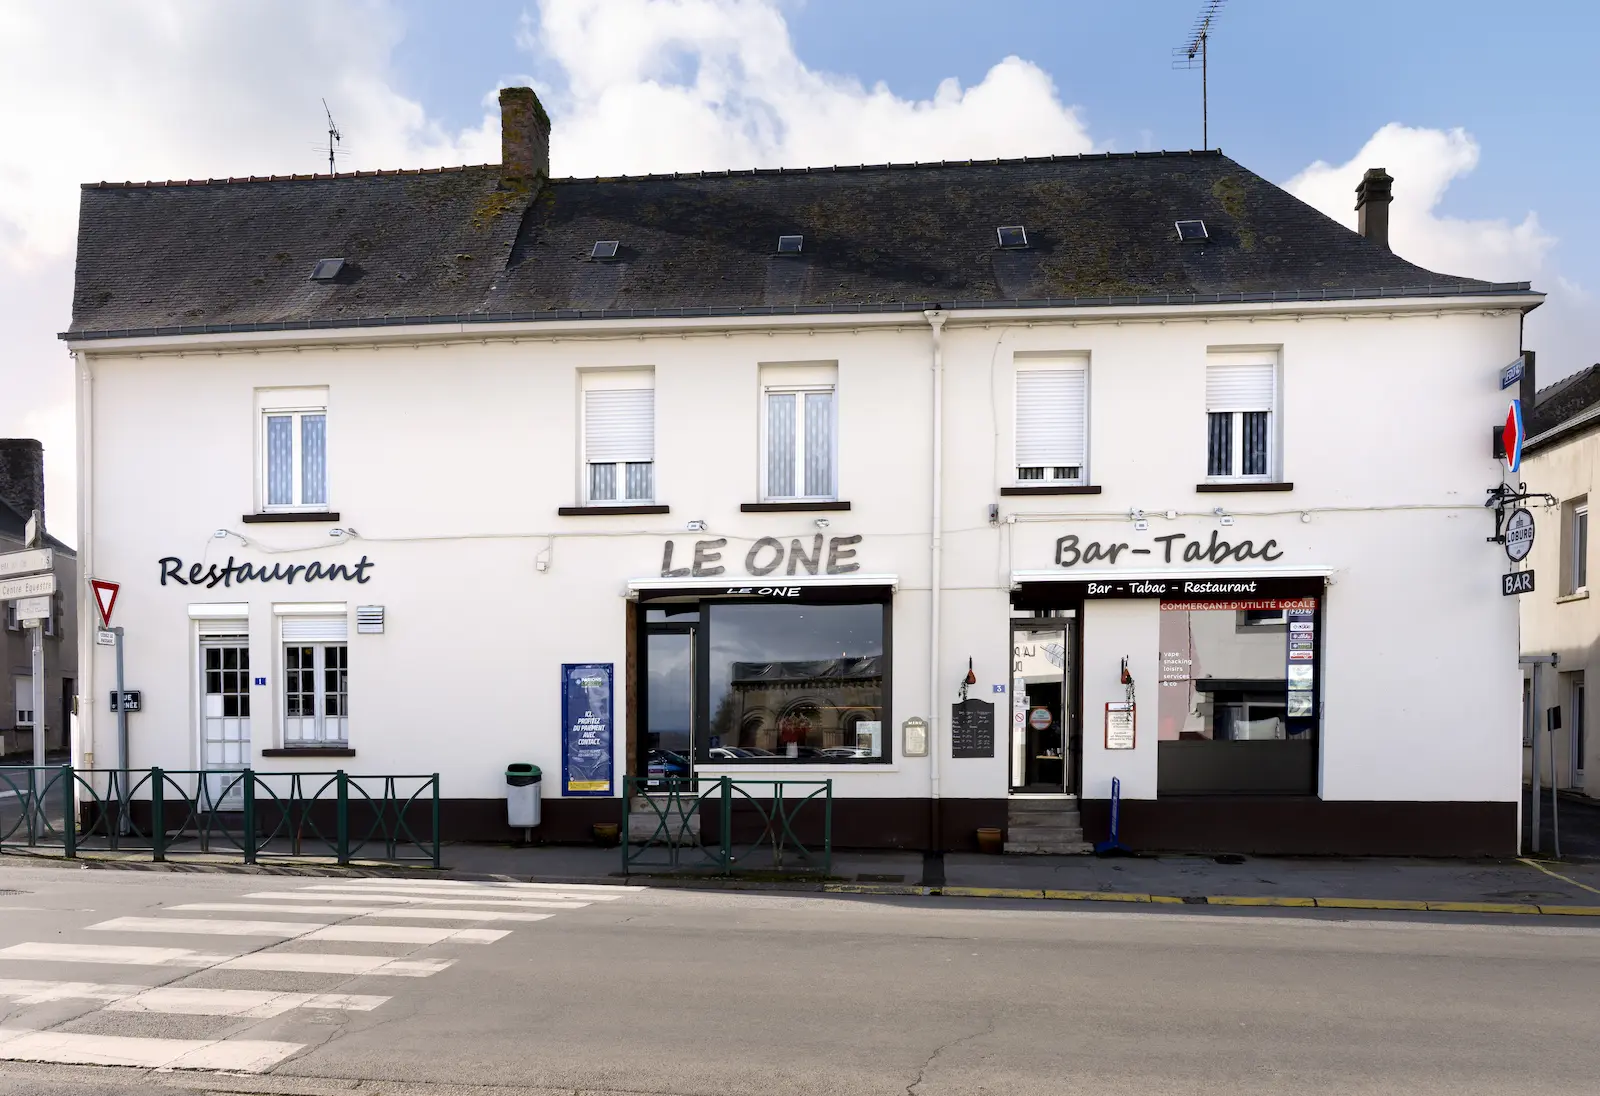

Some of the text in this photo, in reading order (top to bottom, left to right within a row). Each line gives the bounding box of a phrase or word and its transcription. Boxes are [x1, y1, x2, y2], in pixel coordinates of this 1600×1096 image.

[1507, 527, 1533, 543] LOBURG
[661, 533, 863, 578] LE ONE
[158, 555, 375, 589] Restaurant
[1087, 582, 1112, 594] Bar
[1129, 581, 1166, 594] Tabac
[1184, 580, 1257, 593] Restaurant
[1505, 573, 1532, 594] BAR
[758, 586, 802, 597] ONE
[1160, 602, 1229, 611] COMMERÇANT
[1279, 600, 1316, 609] LOCALE
[1163, 652, 1180, 660] vape
